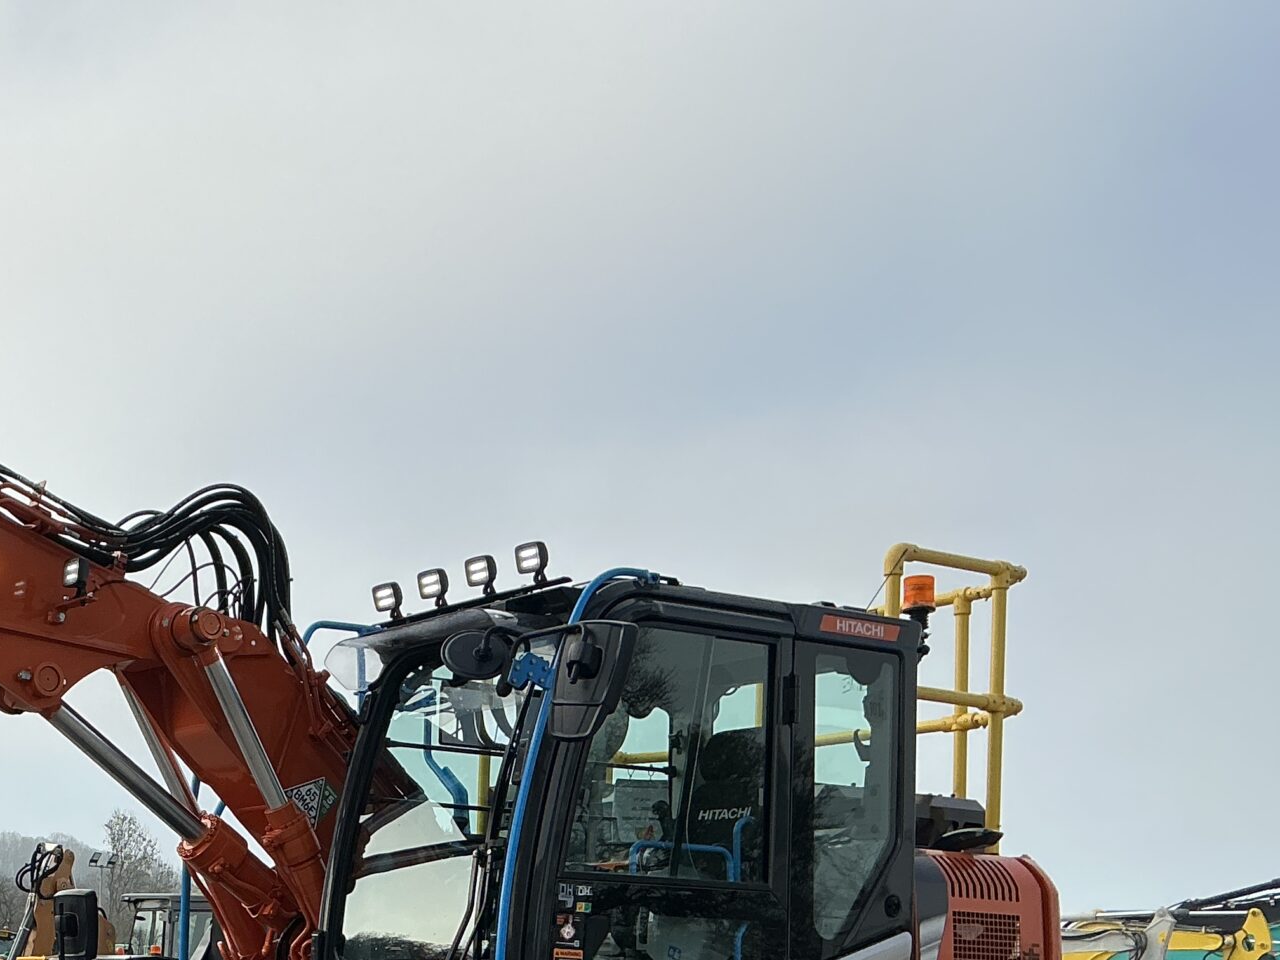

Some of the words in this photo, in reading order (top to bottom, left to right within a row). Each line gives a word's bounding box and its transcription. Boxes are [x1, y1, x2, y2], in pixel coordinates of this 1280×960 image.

[836, 619, 884, 637] HITACHI
[305, 788, 318, 802] 65
[697, 806, 751, 821] HITACHI
